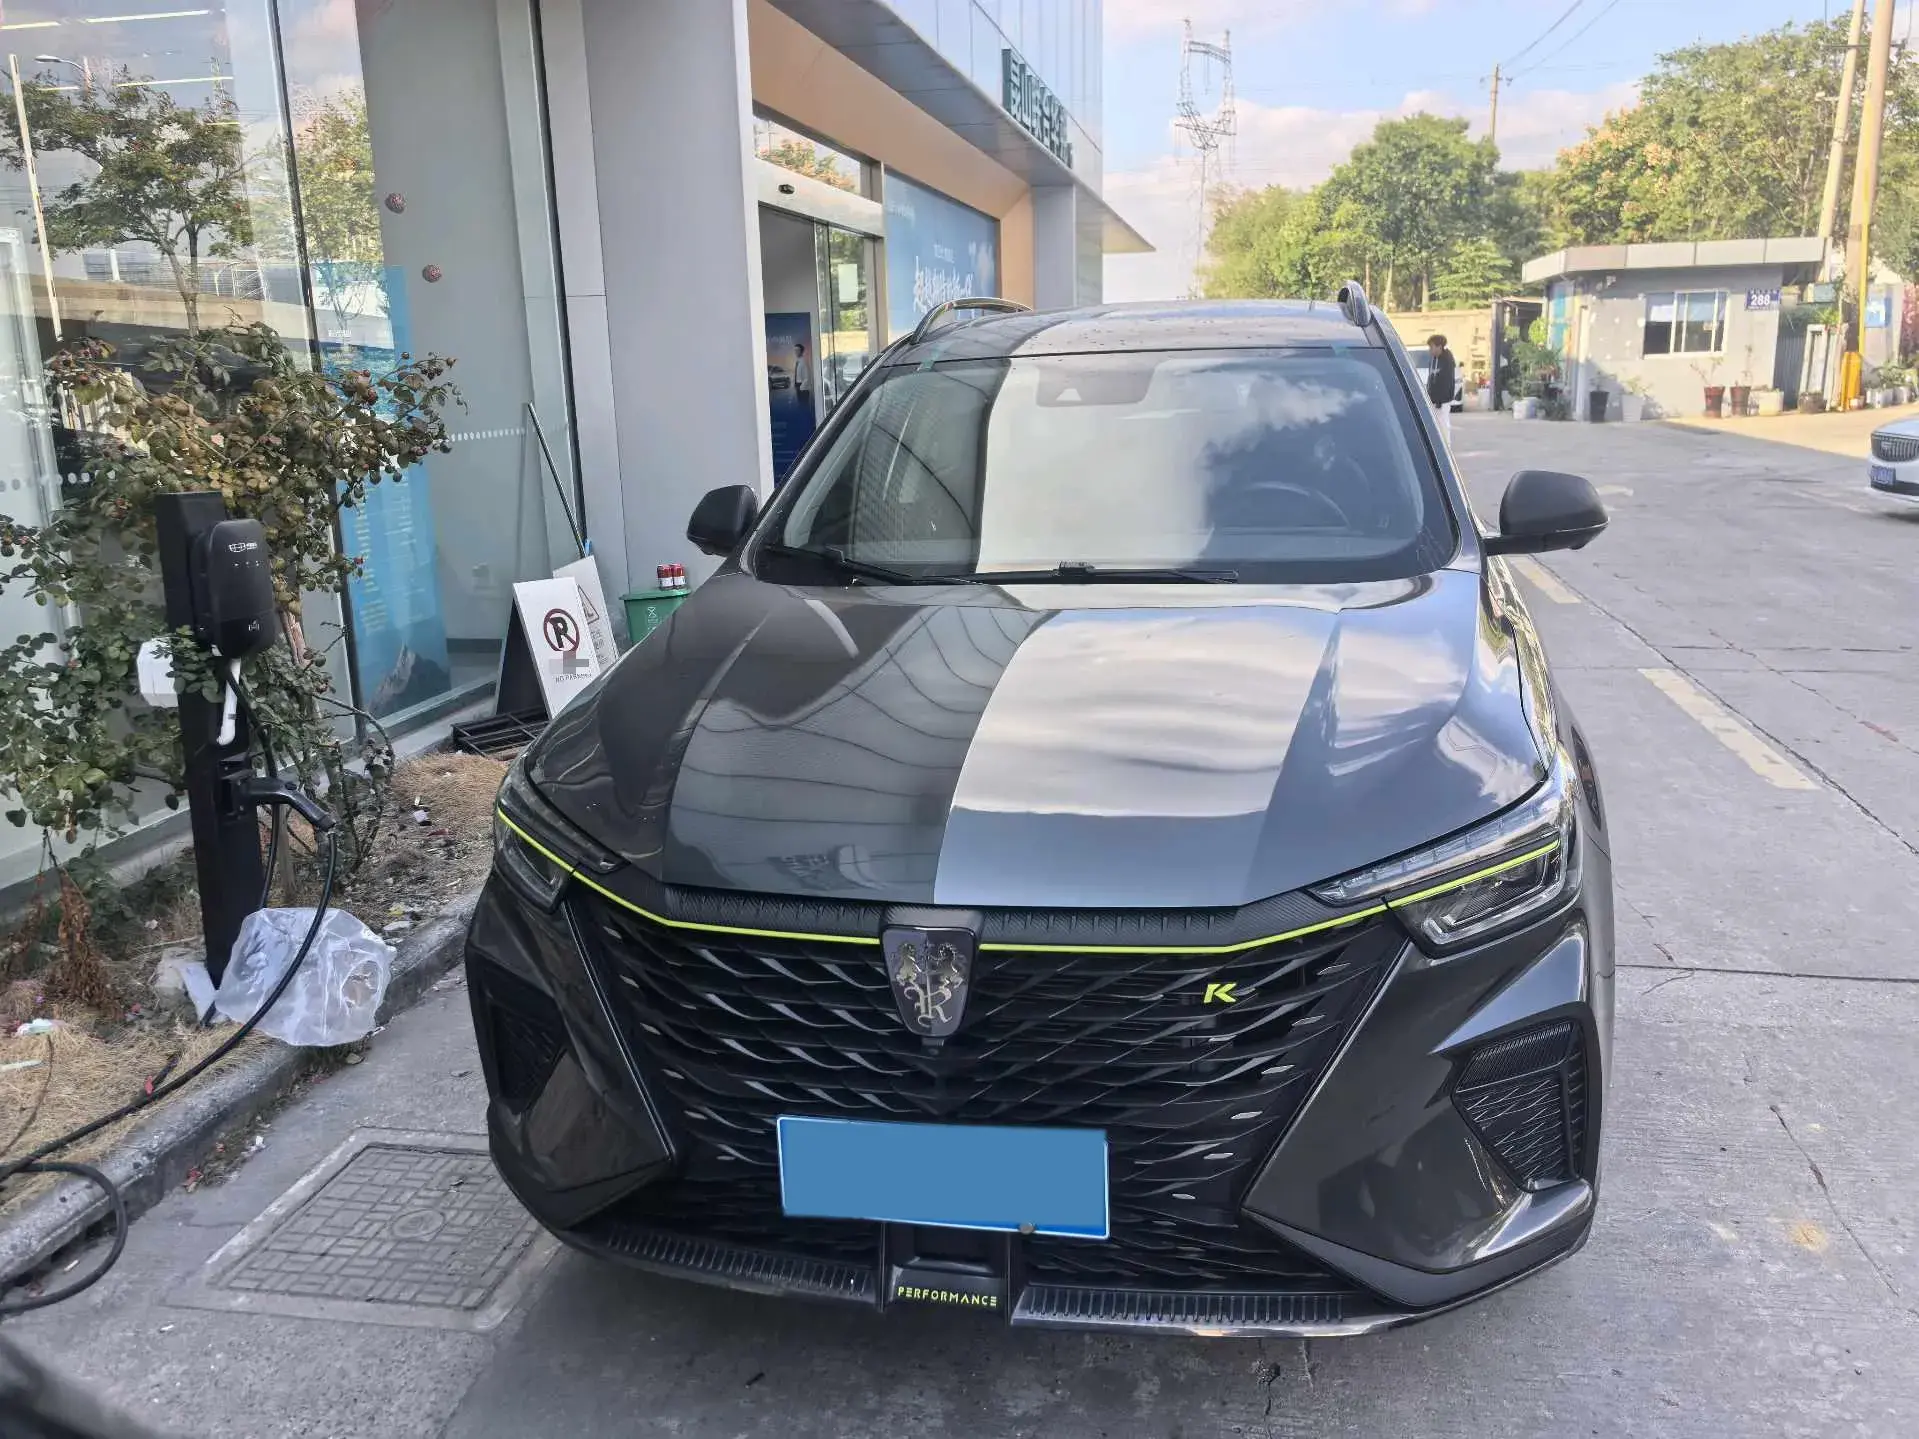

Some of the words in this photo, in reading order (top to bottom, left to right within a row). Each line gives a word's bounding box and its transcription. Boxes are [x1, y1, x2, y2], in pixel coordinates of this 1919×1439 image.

[1751, 294, 1770, 306] 288
[1203, 982, 1237, 1004] K
[897, 1285, 998, 1307] PERFORMANCE
